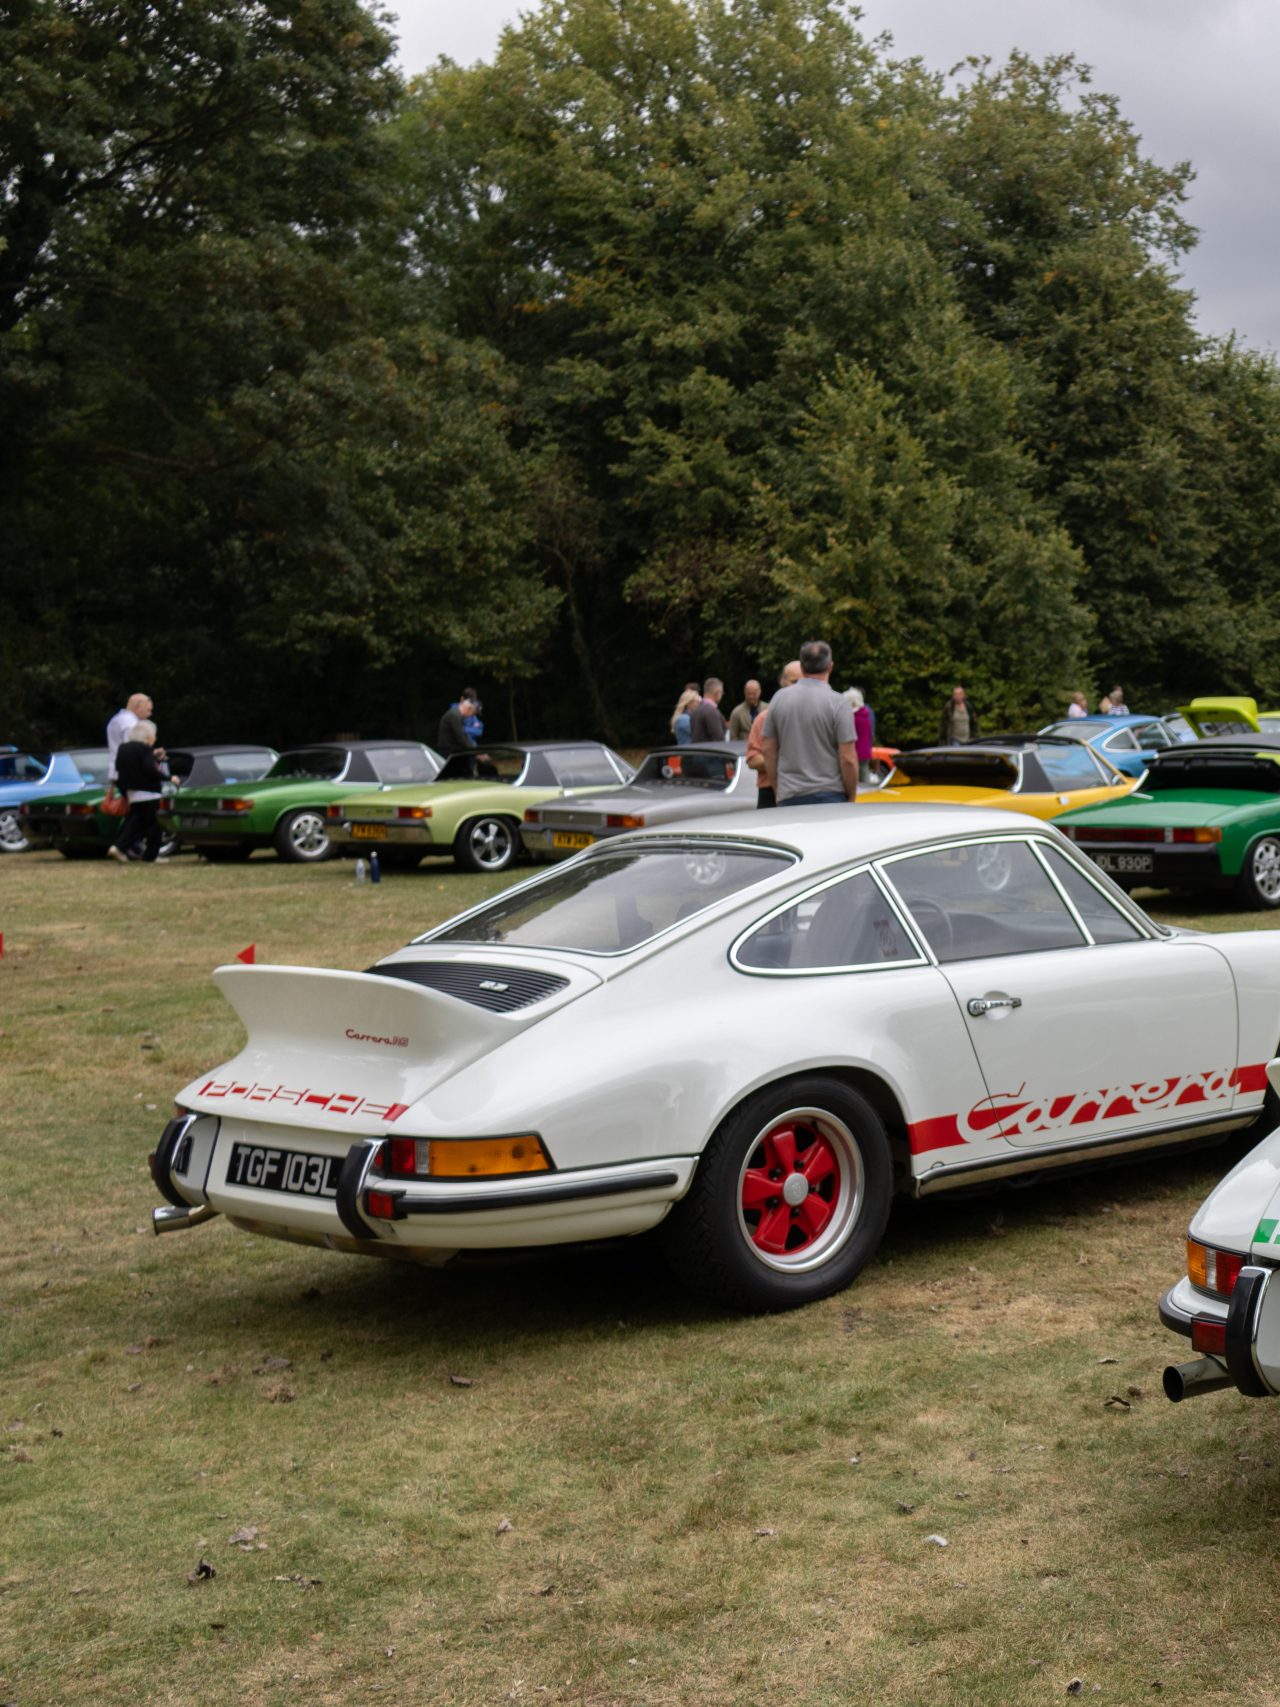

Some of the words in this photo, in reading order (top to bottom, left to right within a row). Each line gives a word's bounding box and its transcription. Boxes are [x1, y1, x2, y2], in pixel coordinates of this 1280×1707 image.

[345, 1028, 392, 1045] Carrera
[200, 1080, 402, 1120] PORSCHE
[957, 1067, 1241, 1146] Carrera
[235, 1145, 279, 1186] TGF
[281, 1152, 338, 1197] 103L
